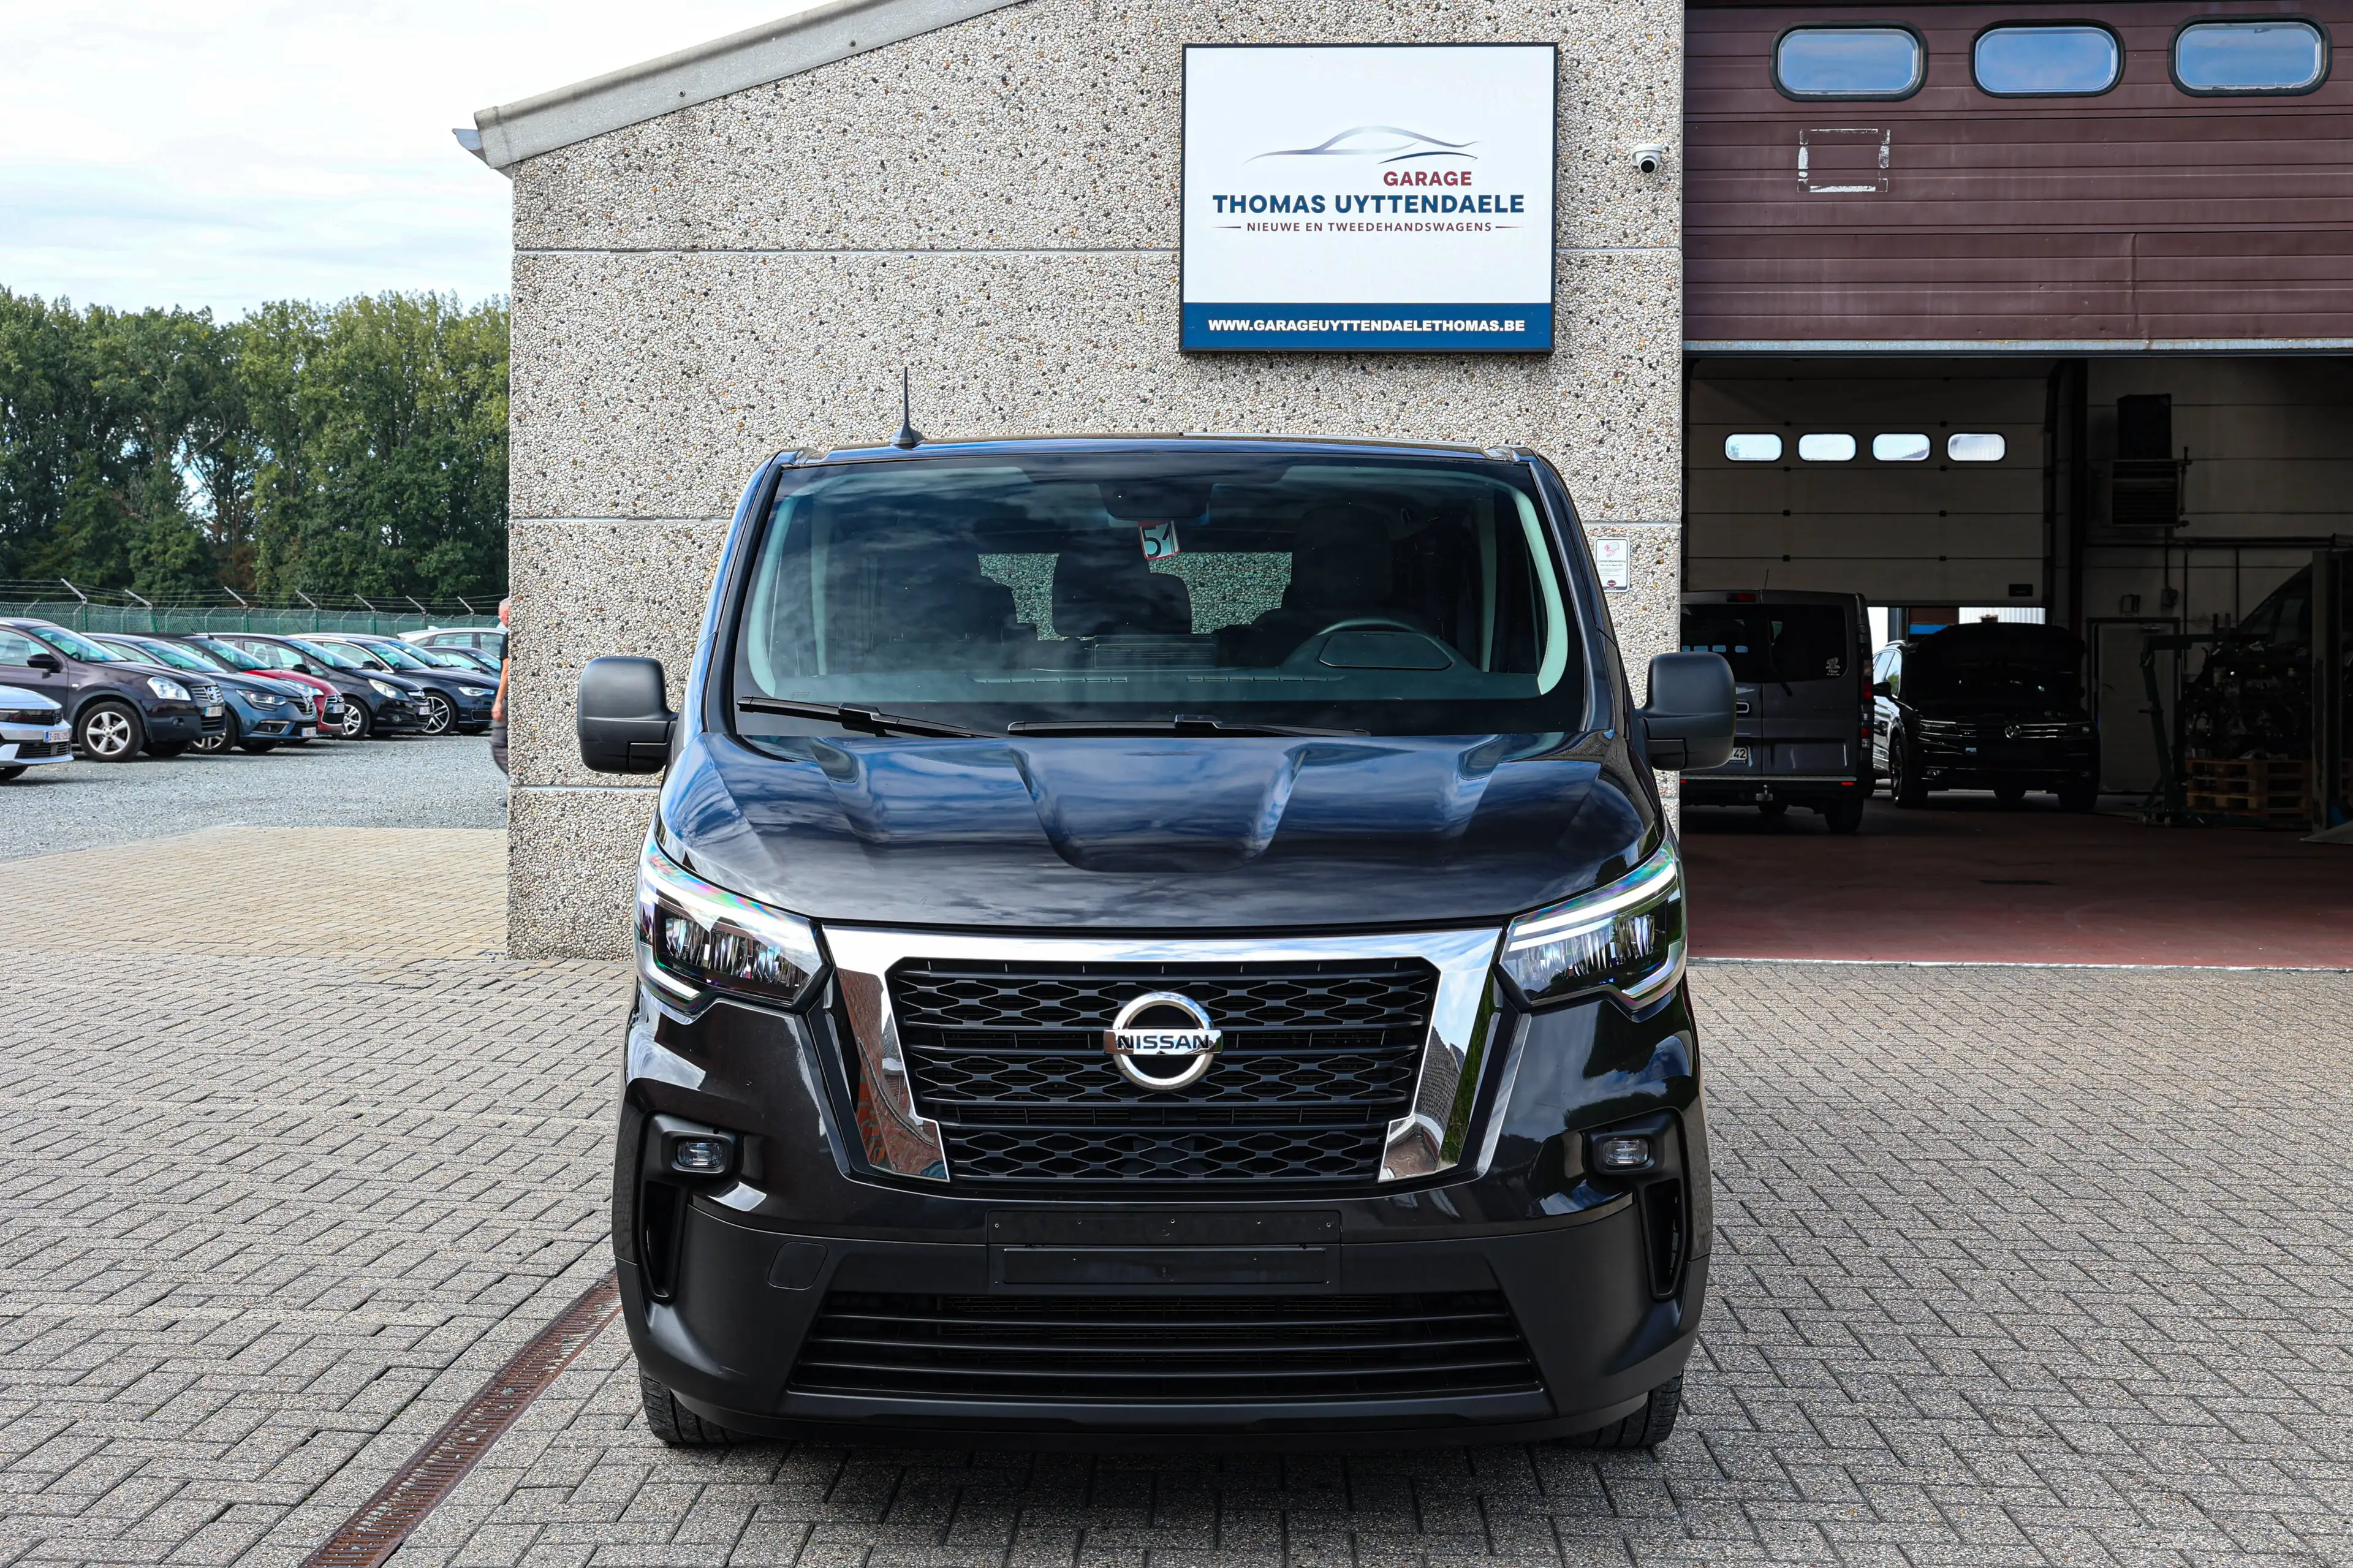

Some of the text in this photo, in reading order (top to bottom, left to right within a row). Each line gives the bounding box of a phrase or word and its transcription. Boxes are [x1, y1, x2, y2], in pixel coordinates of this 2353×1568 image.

[1383, 171, 1472, 186] GARAGE
[1213, 194, 1525, 213] THOMAS UYTTENDAELE
[1247, 222, 1491, 232] NIEUWE EN TWEEDEHANDSWAGENS
[1208, 319, 1525, 331] WWW.GARAGEUYTTENDAELETHOMAS.BE
[1733, 749, 1746, 759] 42
[1117, 1035, 1210, 1050] NISSAN
